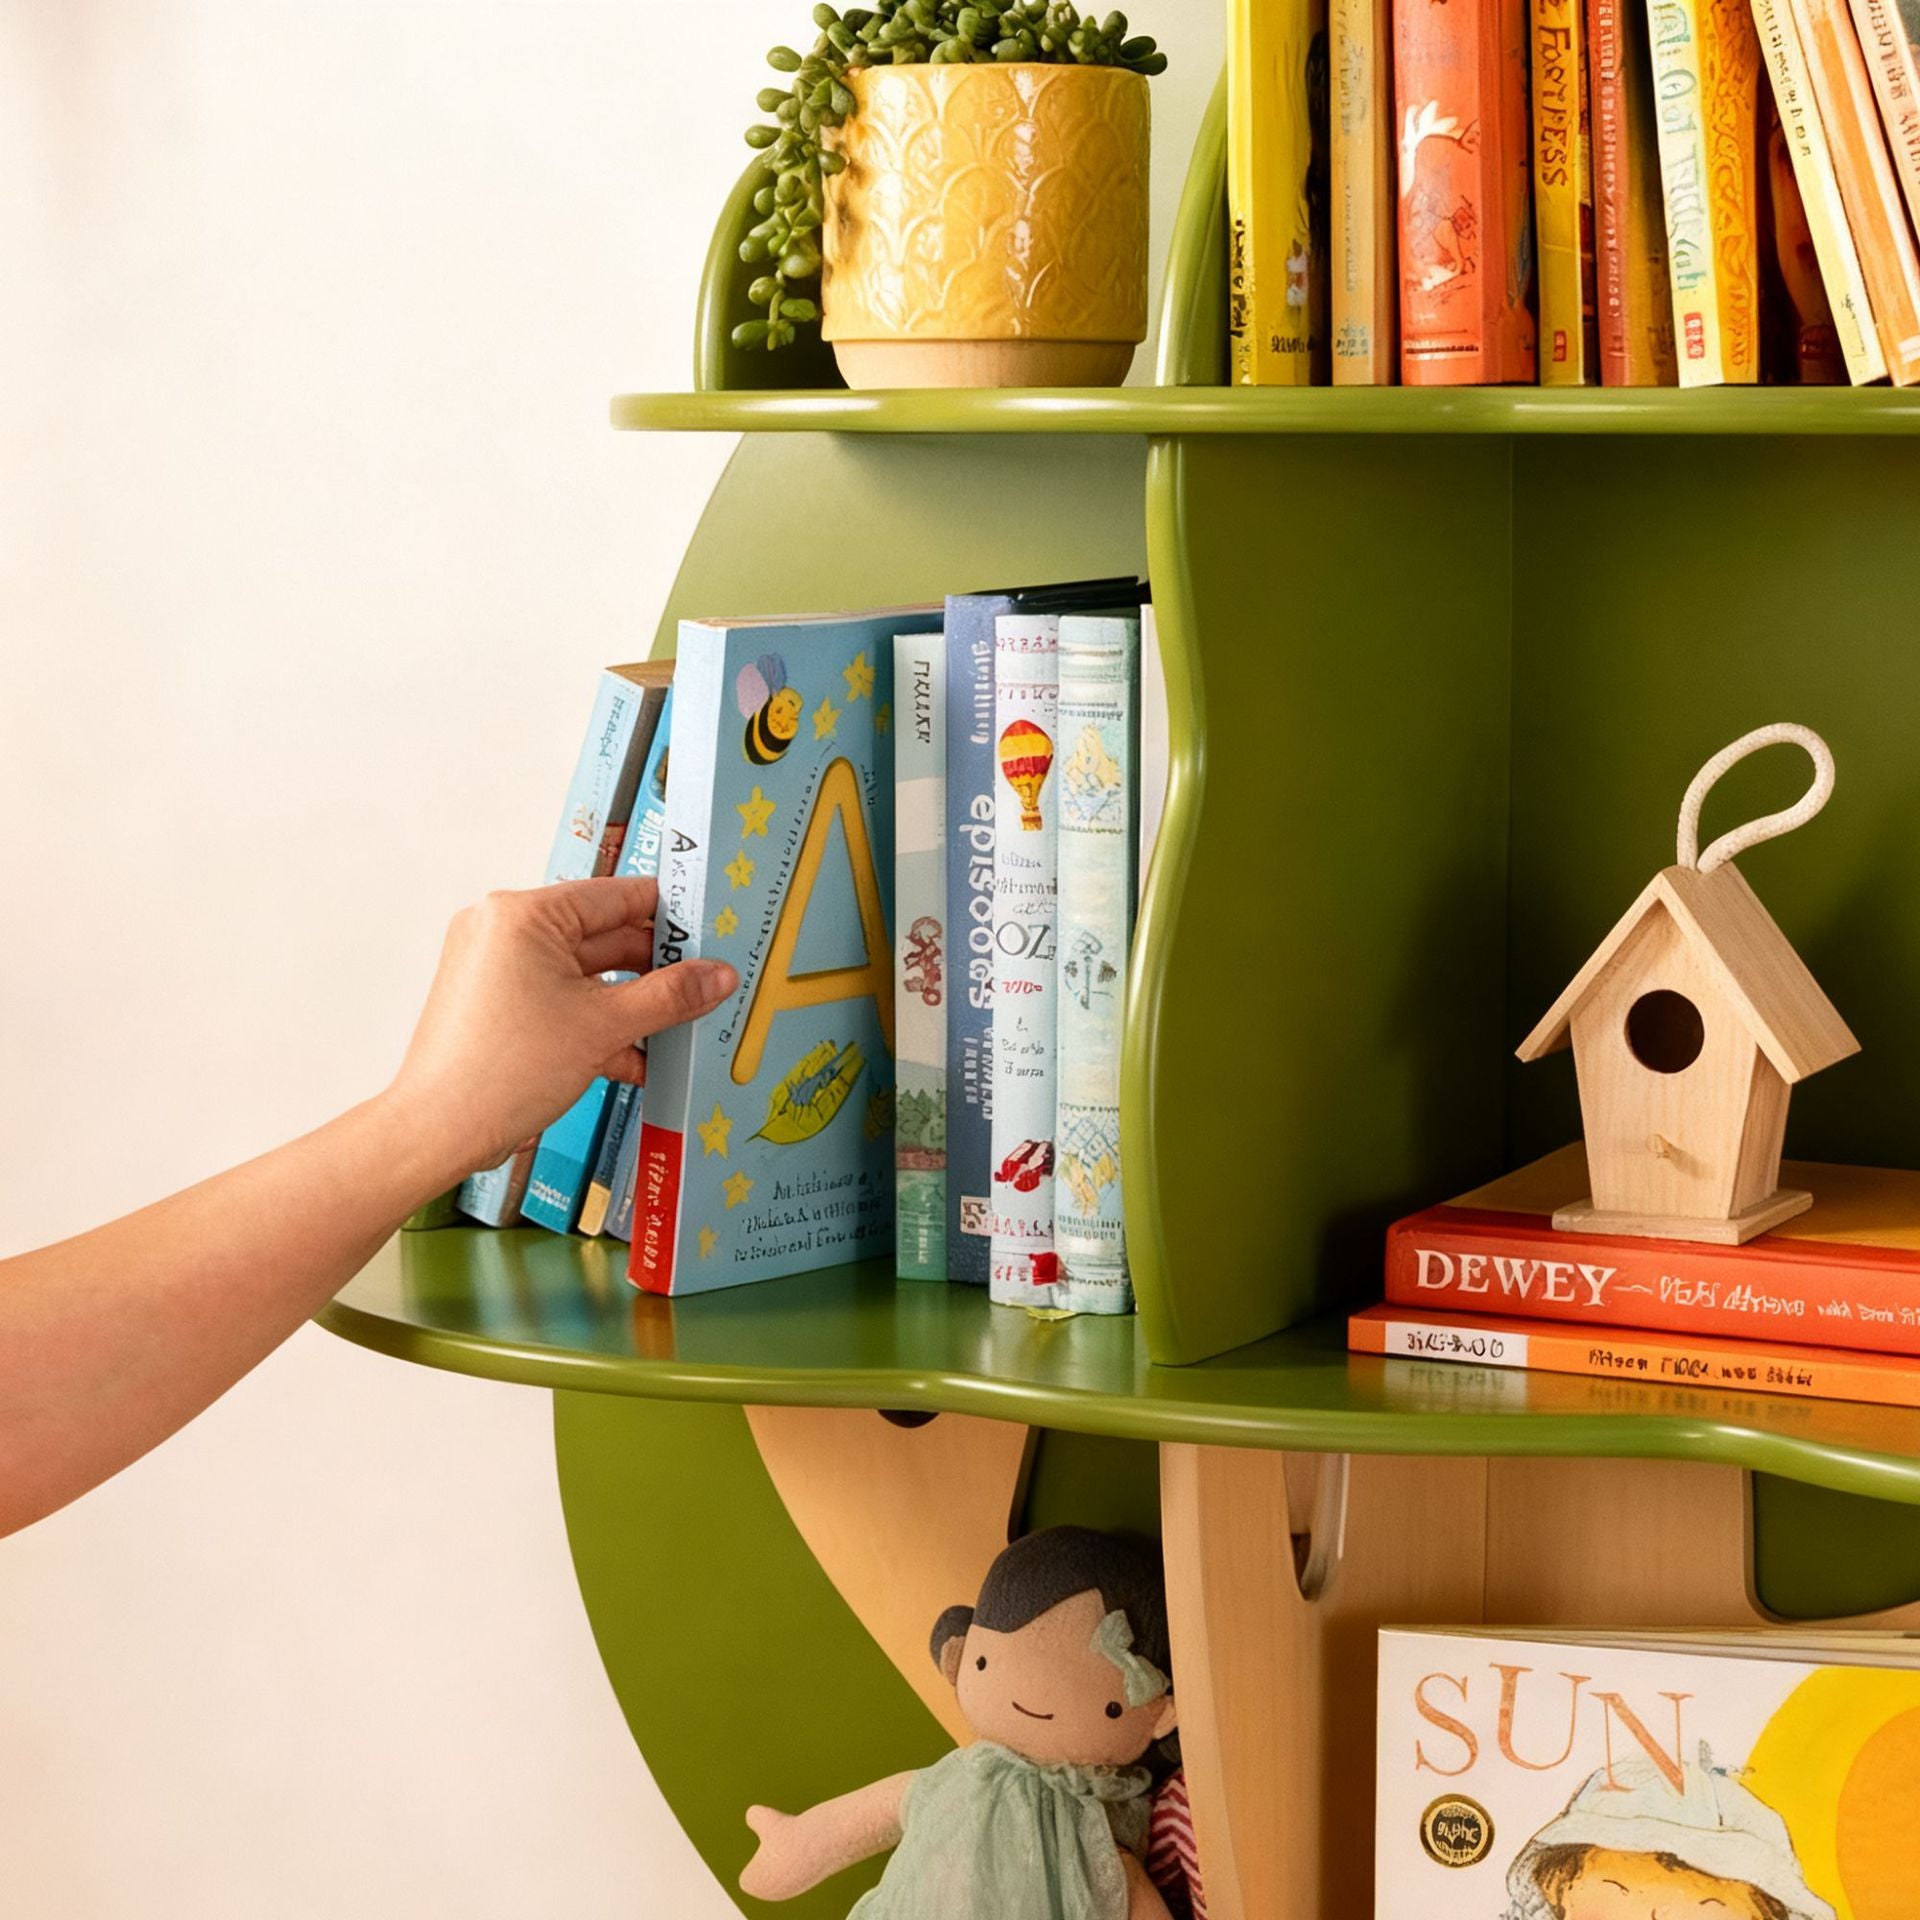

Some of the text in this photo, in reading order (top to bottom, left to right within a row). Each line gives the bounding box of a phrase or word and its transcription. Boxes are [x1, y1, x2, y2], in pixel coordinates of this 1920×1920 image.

[730, 756, 895, 1085] A
[1414, 1249, 1617, 1307] DEWEY
[1414, 1662, 1695, 1797] SUN
